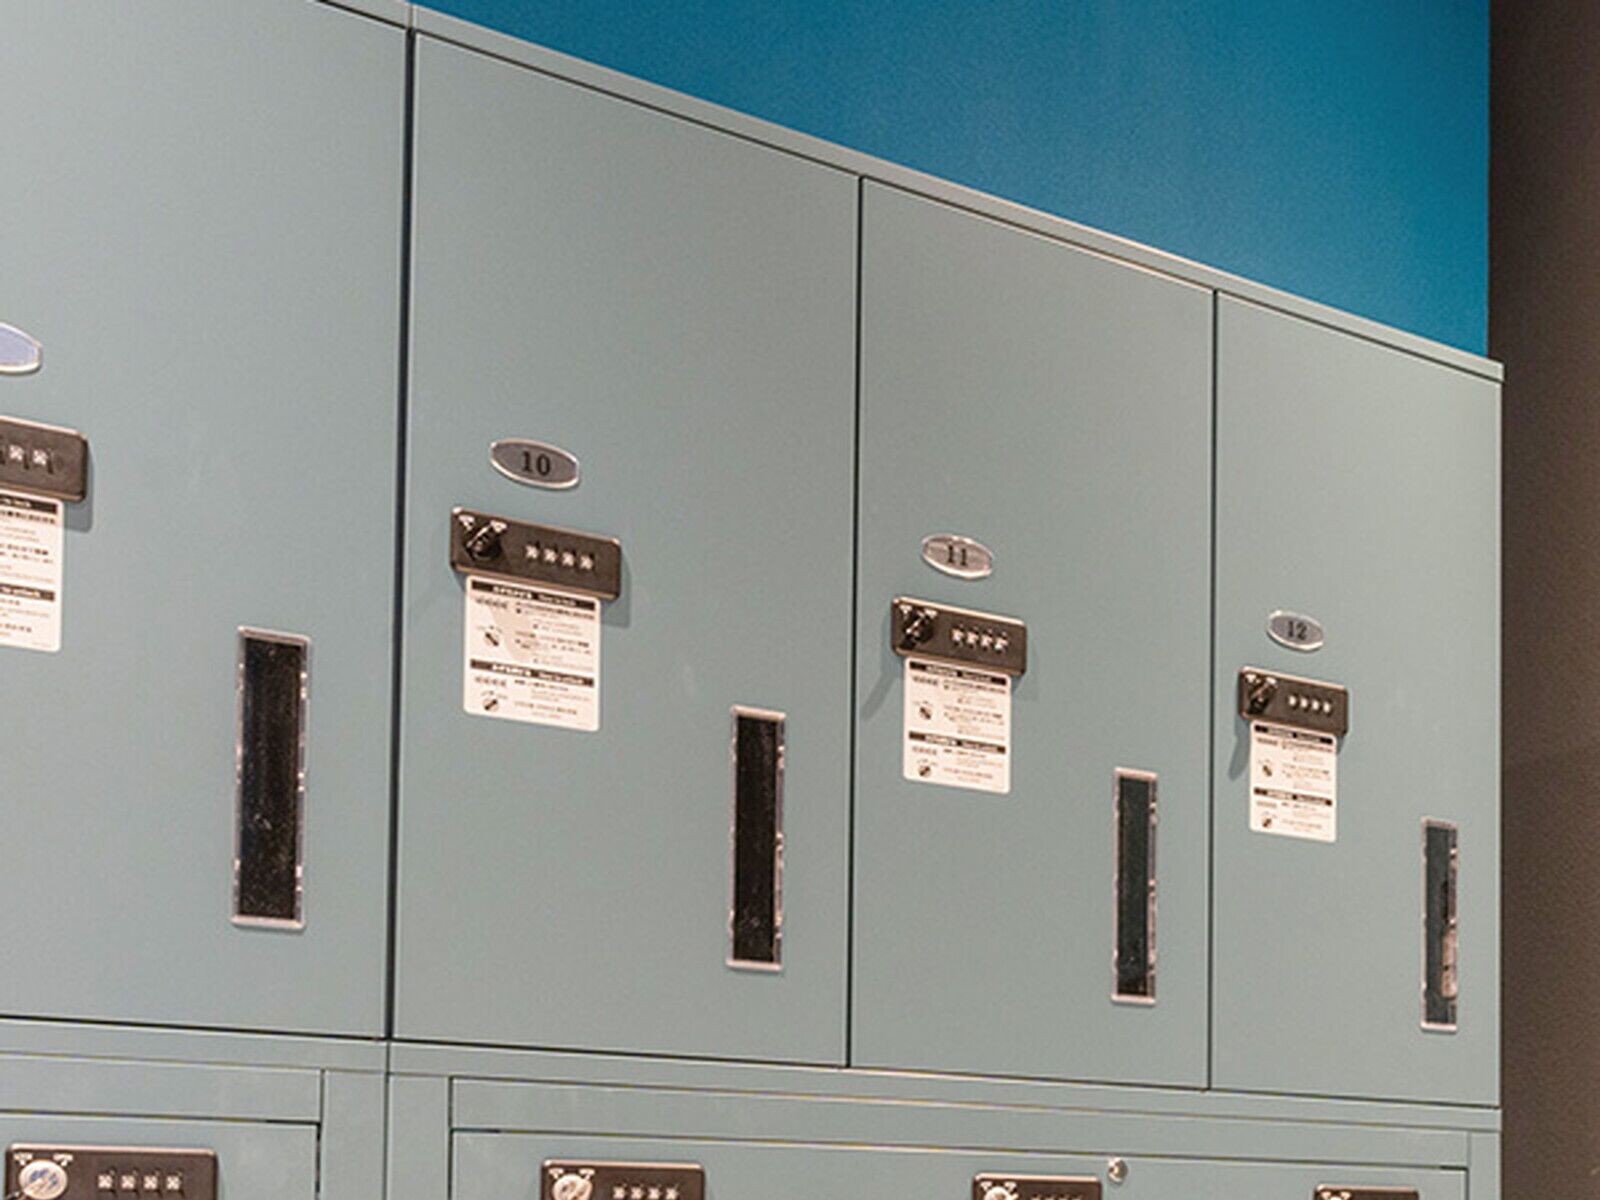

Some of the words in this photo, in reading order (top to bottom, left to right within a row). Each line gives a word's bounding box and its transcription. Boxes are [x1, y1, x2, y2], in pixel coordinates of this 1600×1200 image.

[521, 451, 550, 477] 10
[947, 543, 967, 567] 11
[1286, 620, 1308, 641] 12
